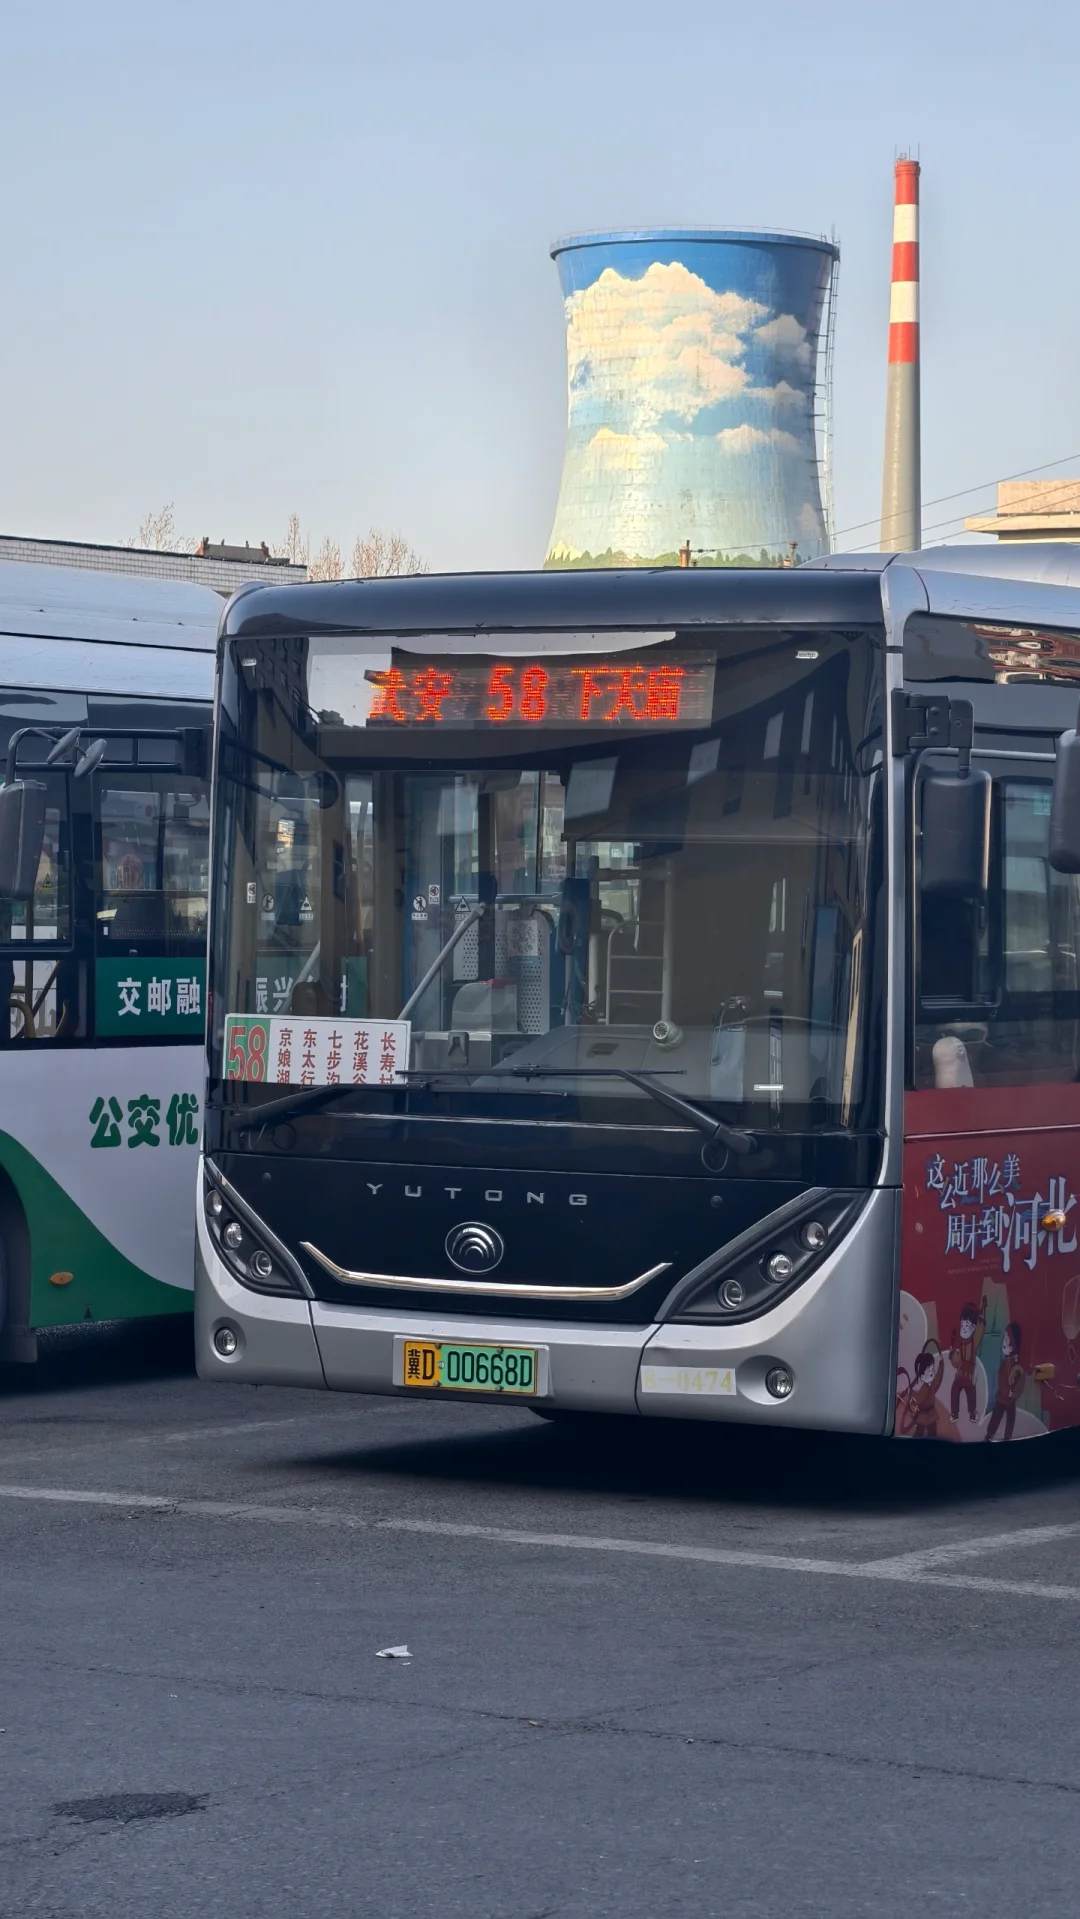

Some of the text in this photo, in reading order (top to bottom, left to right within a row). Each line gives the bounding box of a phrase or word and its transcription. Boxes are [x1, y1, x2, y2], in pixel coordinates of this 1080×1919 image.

[369, 666, 686, 721] 武安 58 下天庙
[117, 977, 201, 1016] 交邮融
[228, 1025, 266, 1082] 58
[277, 1028, 293, 1084] 京娘湖
[301, 1029, 317, 1085] 东太行
[89, 1093, 199, 1148] 公交优
[366, 1183, 588, 1206] YUTONG
[927, 1154, 1020, 1210] 这么近那么美
[944, 1176, 1078, 1273] 周末到河北
